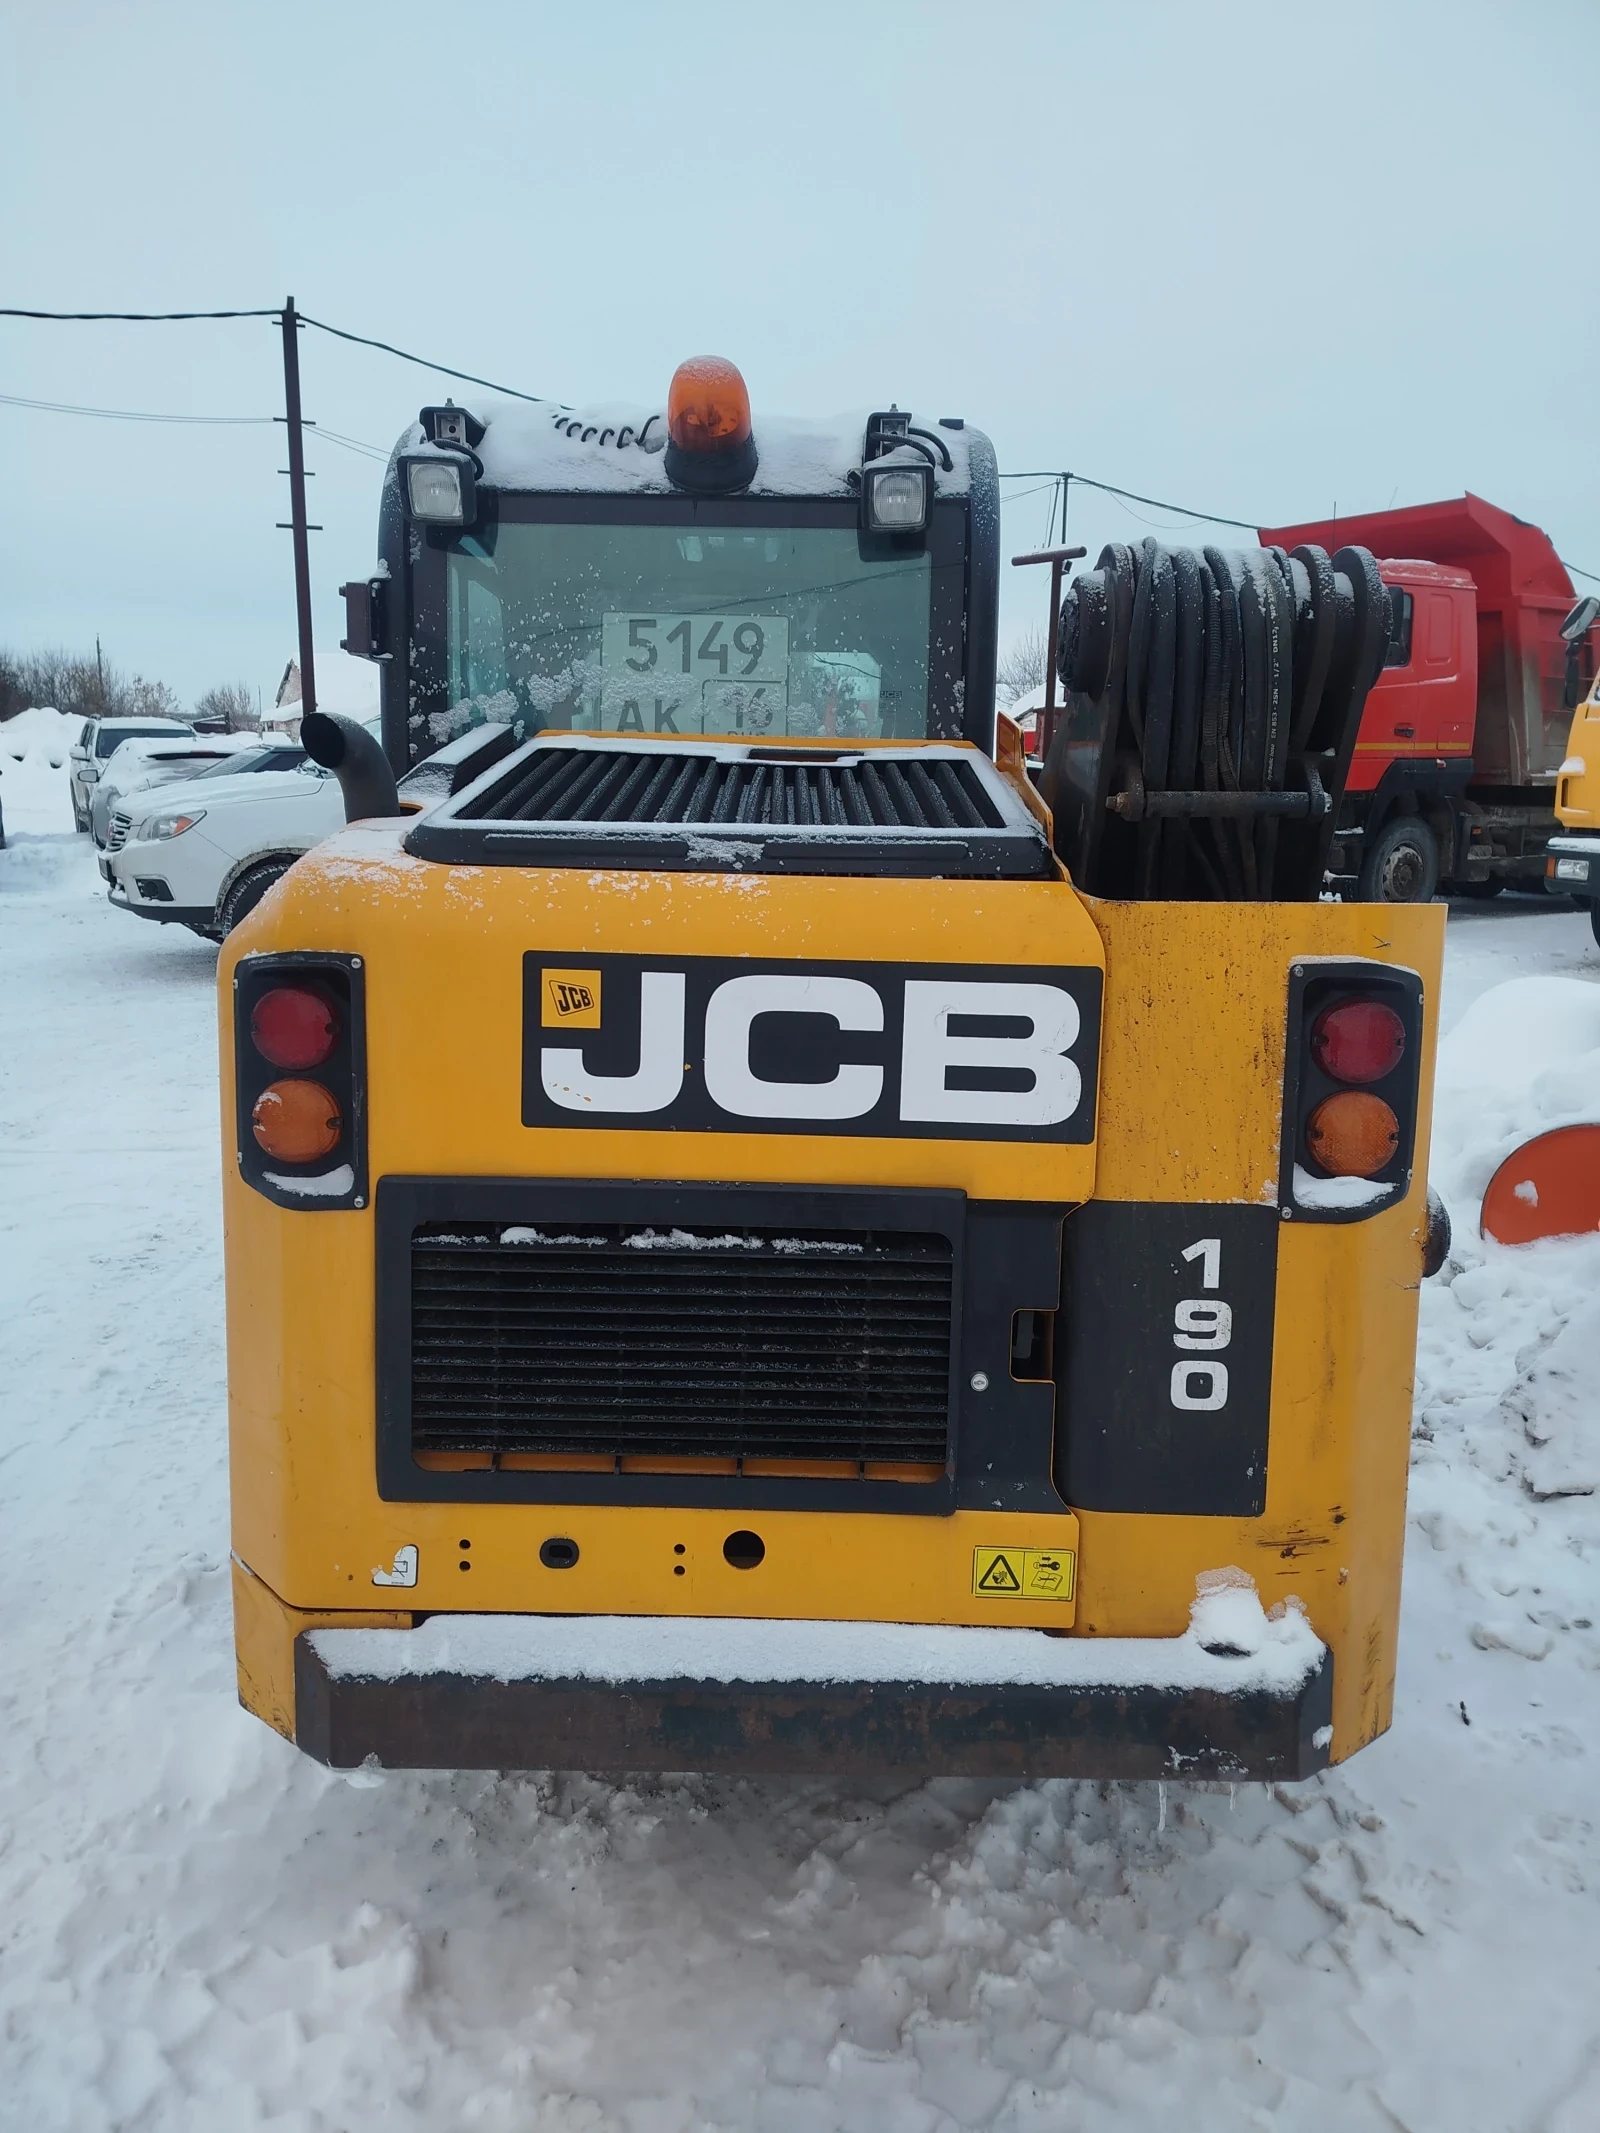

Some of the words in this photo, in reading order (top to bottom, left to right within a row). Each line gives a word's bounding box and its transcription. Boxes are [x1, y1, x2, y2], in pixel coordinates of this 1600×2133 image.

[625, 618, 765, 675] 5149
[1271, 728, 1277, 739] EN
[556, 984, 592, 1013] JCB
[540, 971, 1082, 1127] JCB
[1170, 1238, 1233, 1411] 190
